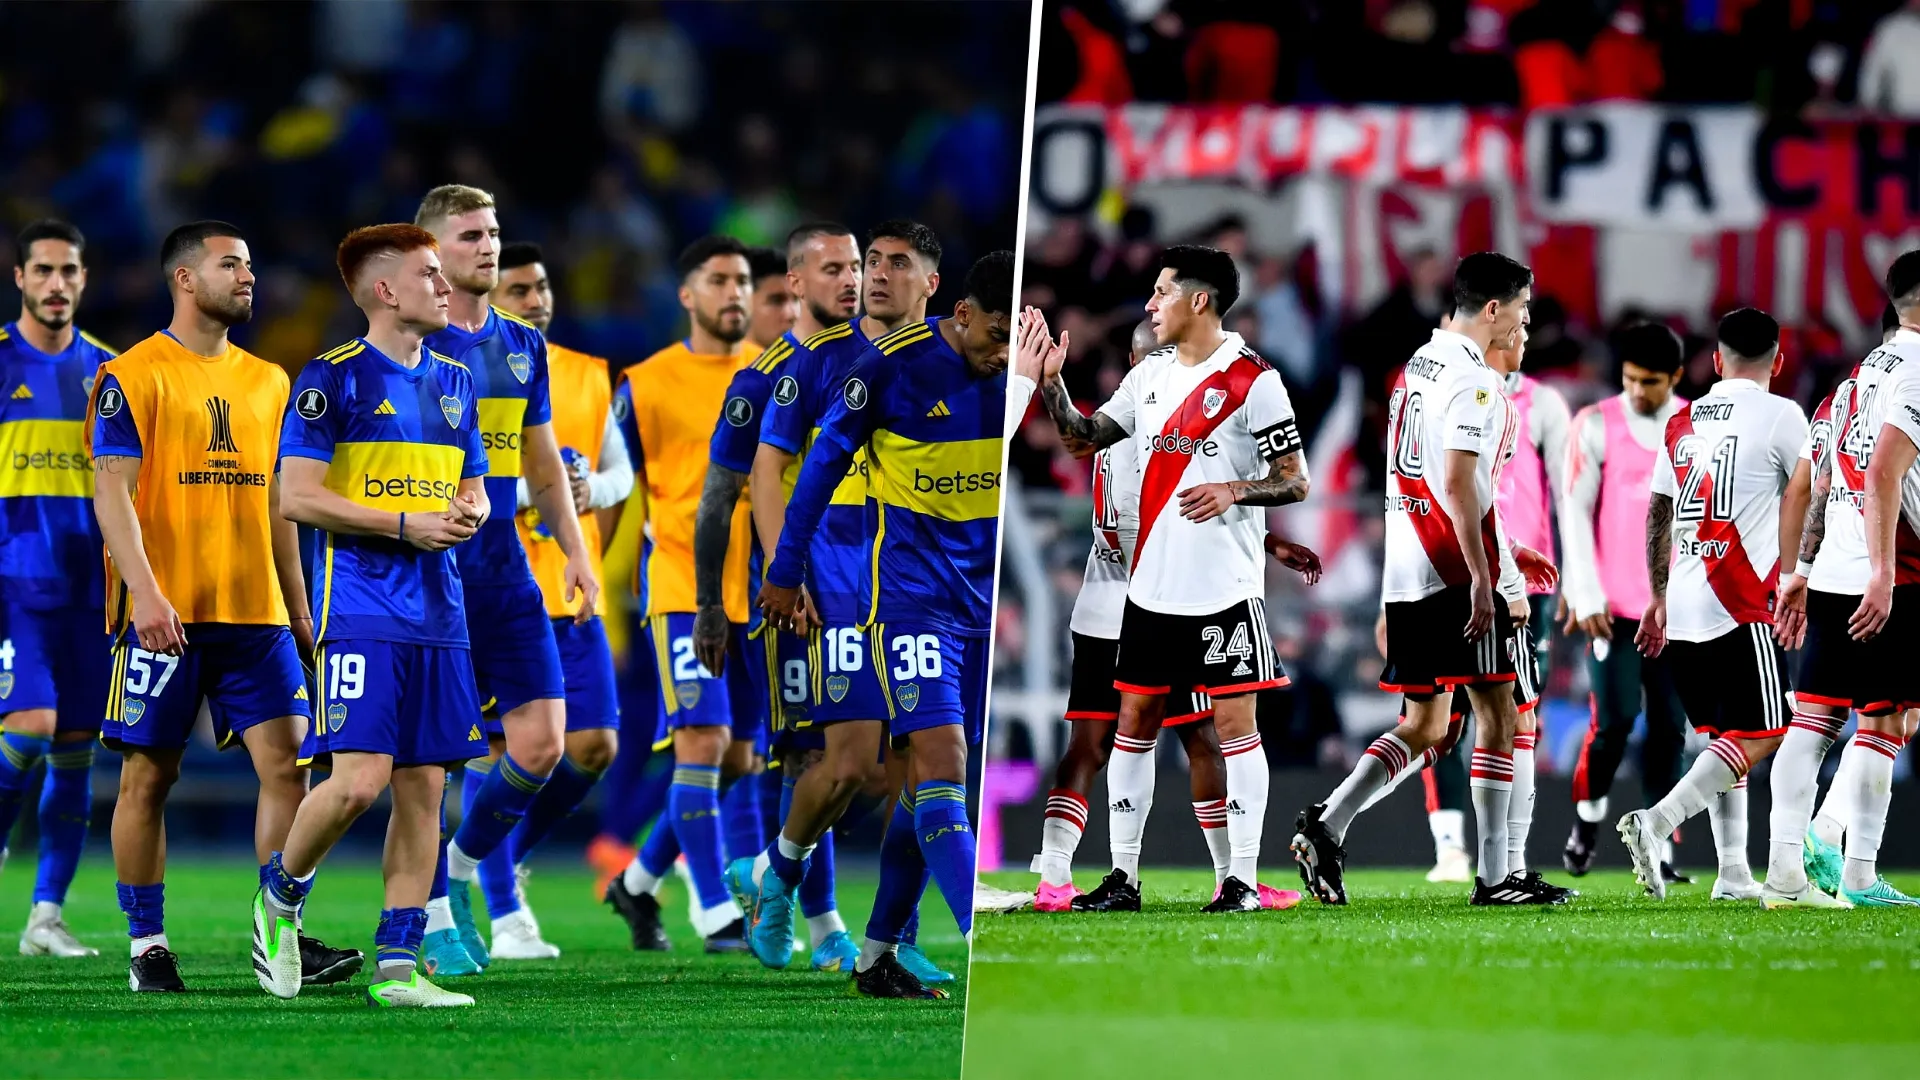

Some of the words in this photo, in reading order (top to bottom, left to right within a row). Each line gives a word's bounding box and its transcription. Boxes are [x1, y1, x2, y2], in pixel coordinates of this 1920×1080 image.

[1692, 403, 1734, 422] BARCO
[178, 471, 266, 487] LIBERTADORES
[1674, 434, 1738, 522] 21
[825, 627, 863, 673] 16
[892, 633, 942, 681] 36
[1202, 621, 1253, 665] 24
[126, 647, 179, 697] 57
[329, 653, 366, 699] 19
[783, 659, 807, 703] 9
